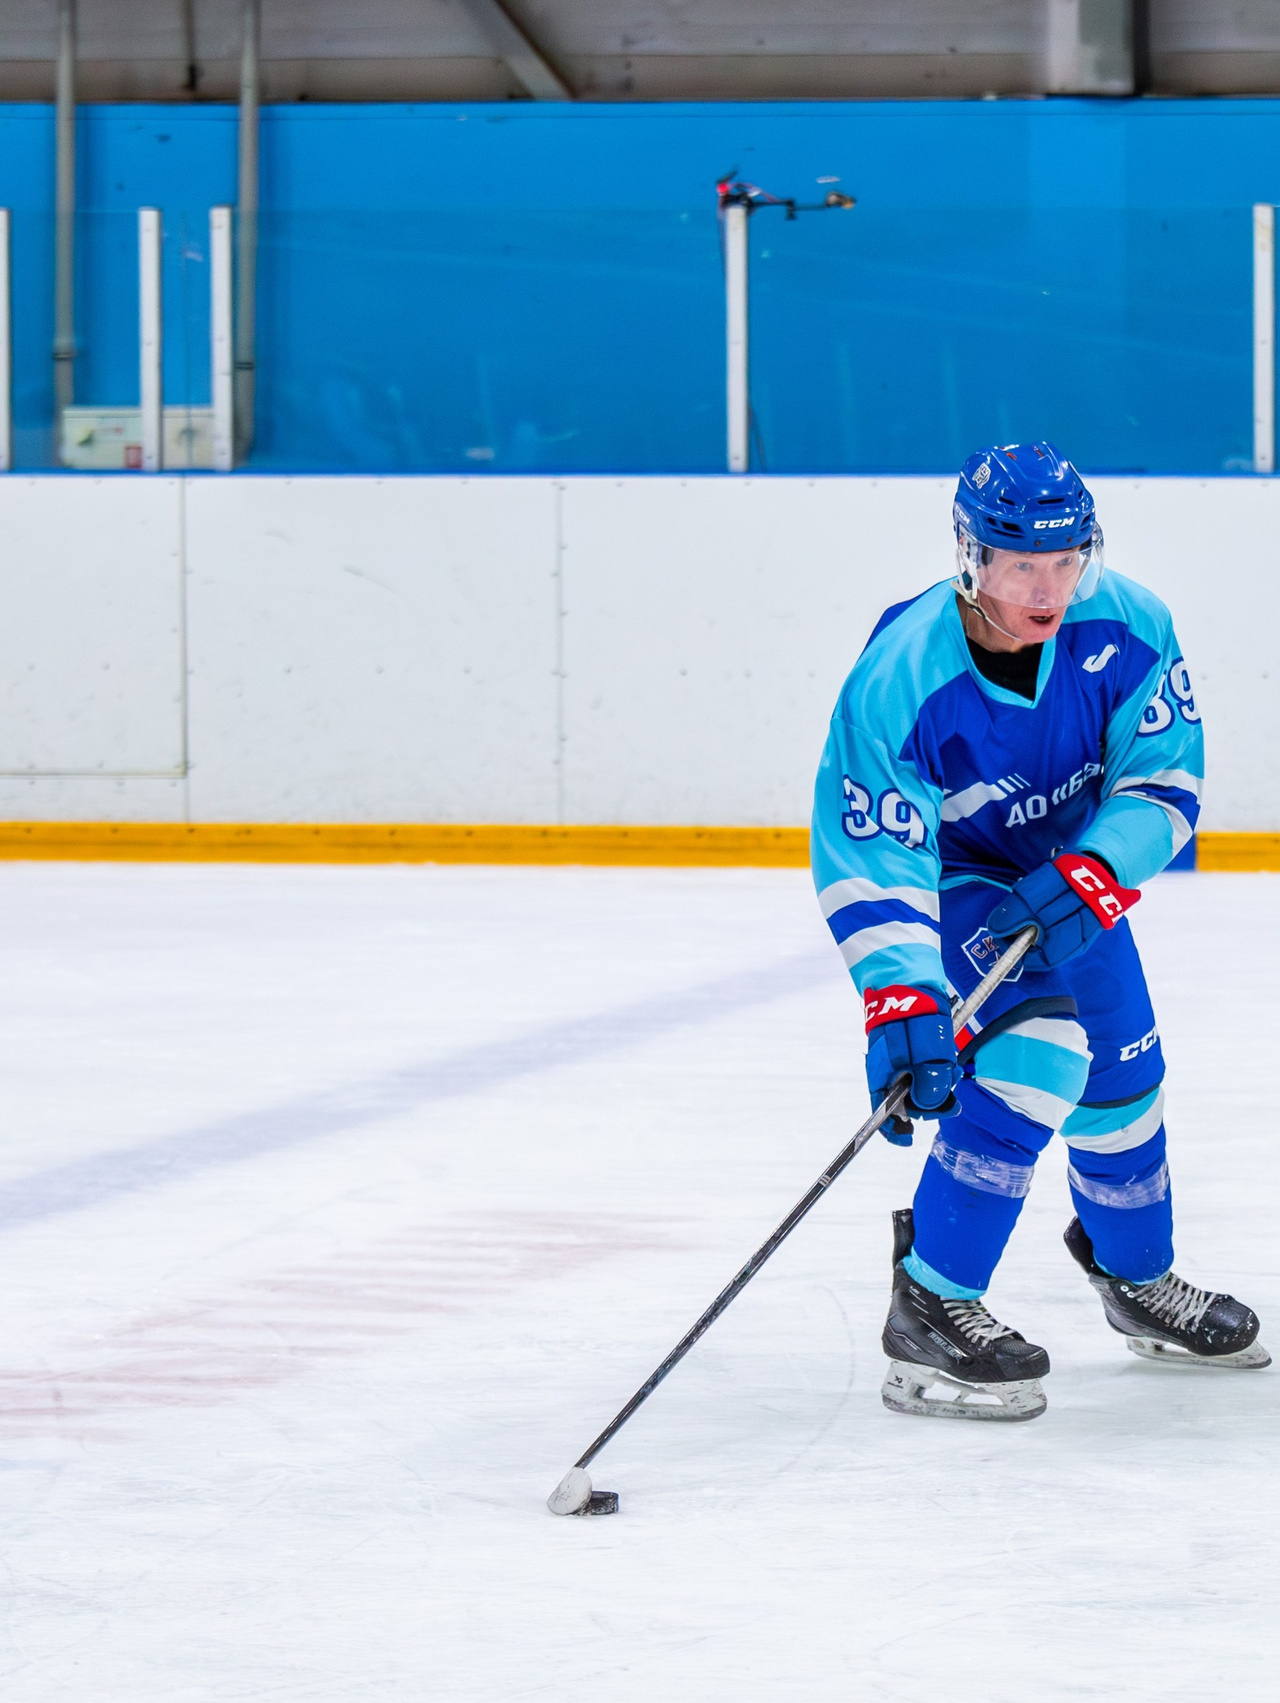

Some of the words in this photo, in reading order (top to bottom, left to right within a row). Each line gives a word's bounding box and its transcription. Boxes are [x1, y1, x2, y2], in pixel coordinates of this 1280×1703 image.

[1033, 516, 1076, 530] CCM
[842, 774, 929, 849] 39
[1070, 865, 1124, 923] CC
[971, 936, 999, 959] СК
[865, 996, 918, 1022] CM
